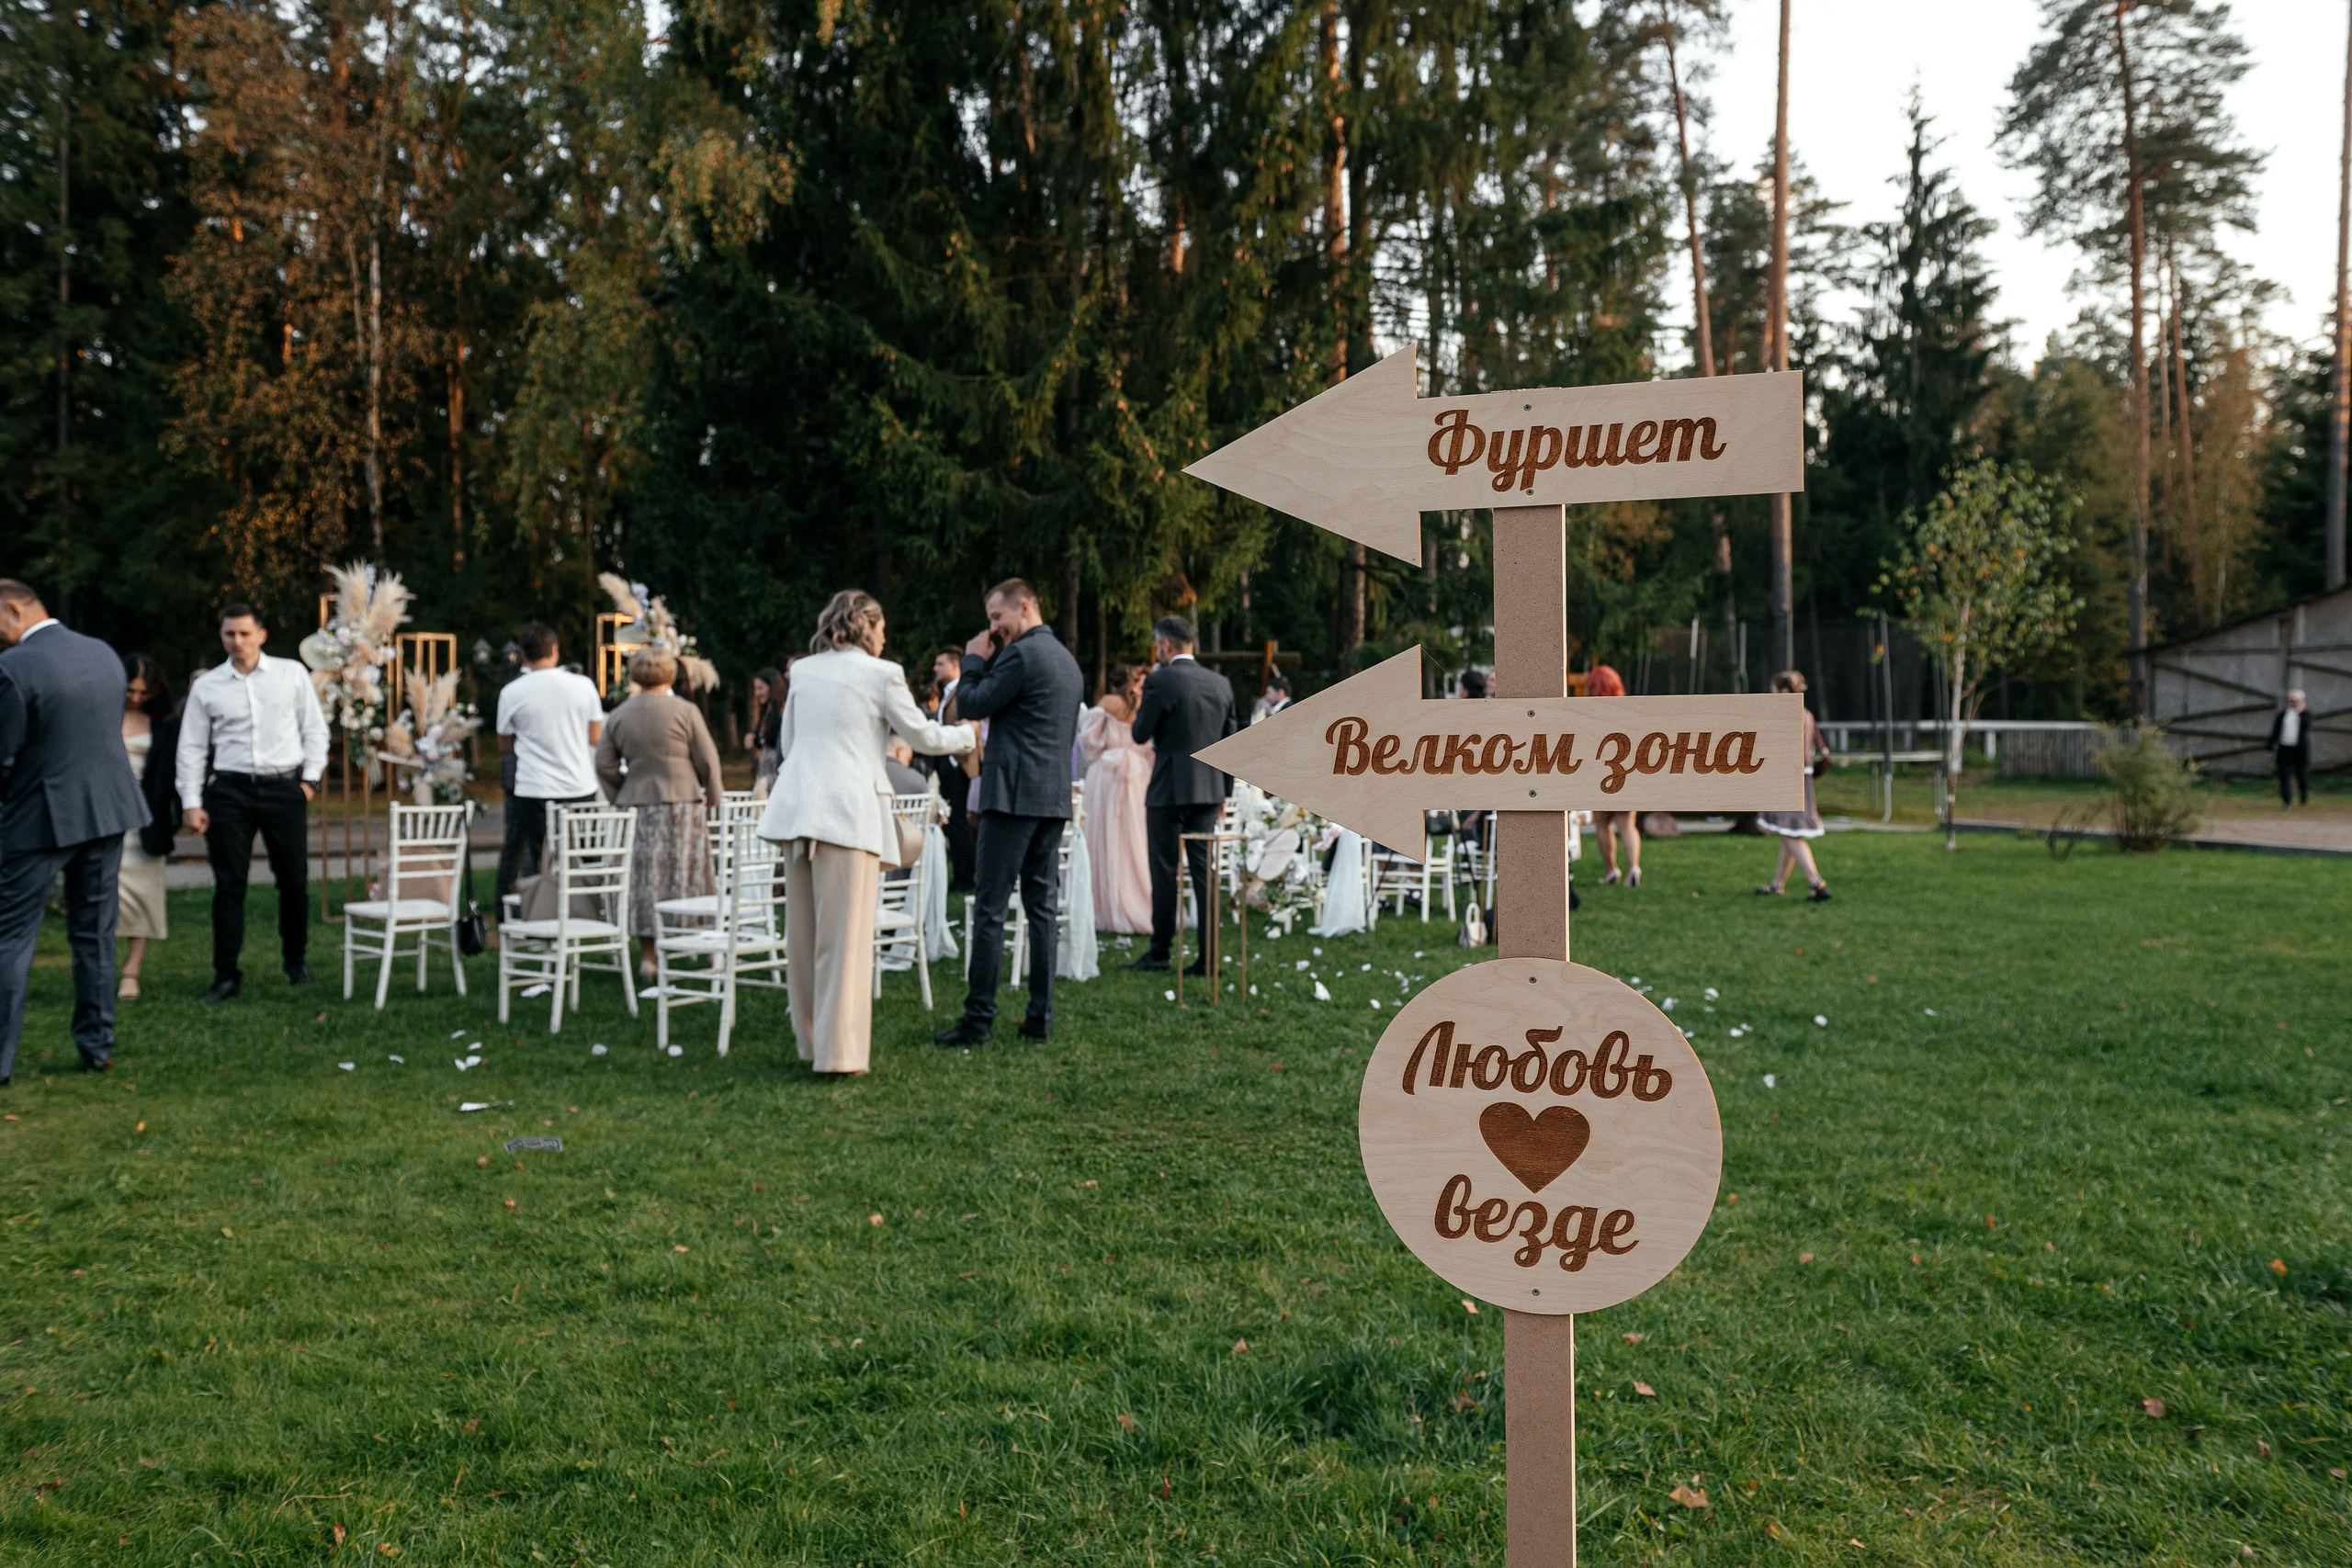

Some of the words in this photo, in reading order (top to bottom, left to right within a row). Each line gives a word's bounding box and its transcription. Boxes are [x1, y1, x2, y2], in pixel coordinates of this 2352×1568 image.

[1427, 409, 1727, 492] Фуршет
[1325, 716, 1583, 776] Велком
[1595, 731, 1766, 795] зона
[1401, 1020, 1673, 1102] Любовь
[1433, 1173, 1640, 1273] везде
